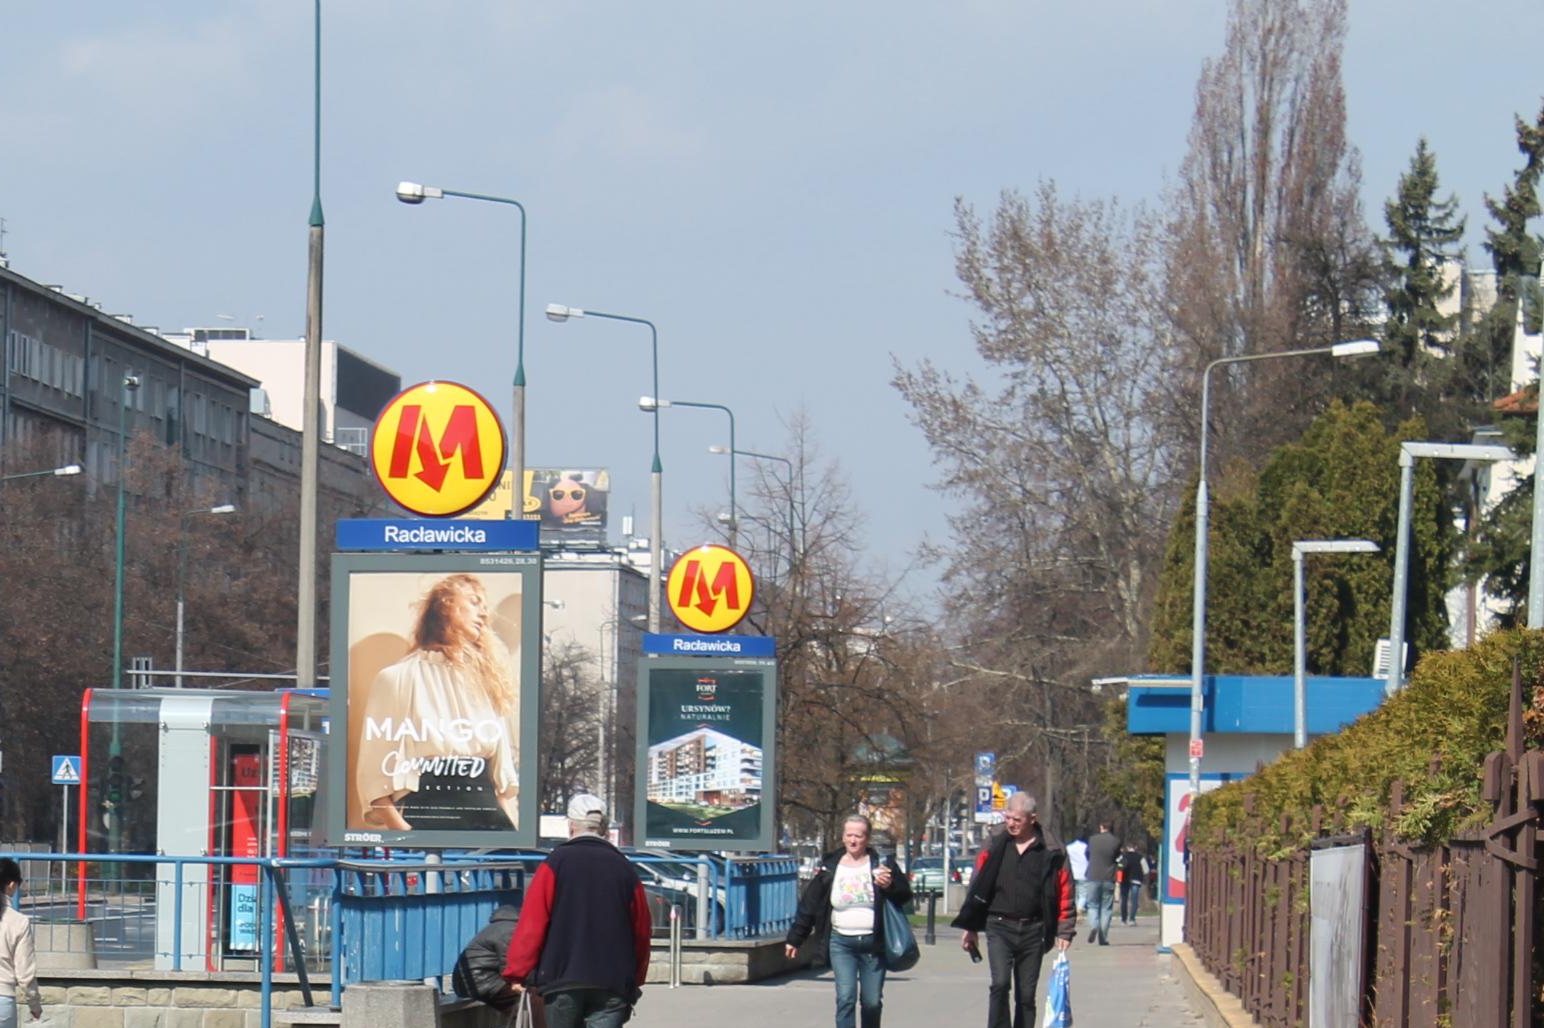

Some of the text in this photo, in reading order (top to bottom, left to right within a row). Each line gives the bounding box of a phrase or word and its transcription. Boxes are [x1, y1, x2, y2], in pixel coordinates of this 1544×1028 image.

[384, 526, 486, 543] Racławicka
[673, 639, 741, 652] Racławicka
[696, 685, 717, 693] FORT
[366, 717, 503, 742] MANGO
